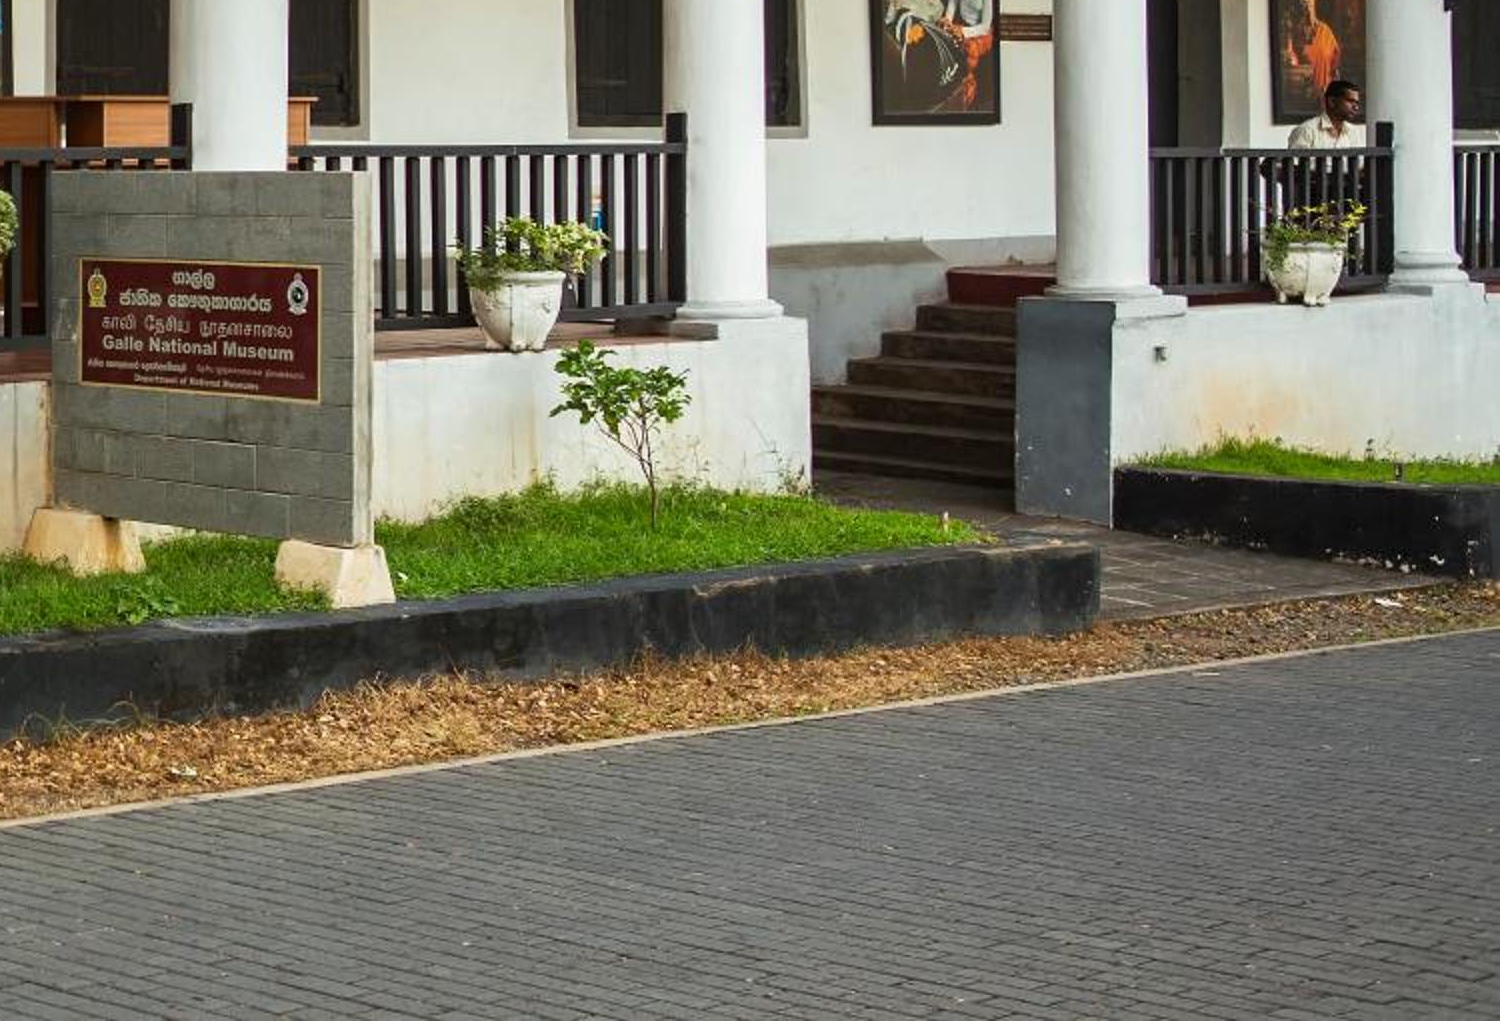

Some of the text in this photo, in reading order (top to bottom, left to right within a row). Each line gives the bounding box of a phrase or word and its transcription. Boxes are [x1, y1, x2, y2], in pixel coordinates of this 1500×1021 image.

[172, 267, 215, 290] ගාල්ල
[119, 288, 162, 307] ජාතික
[101, 313, 137, 330] காலி
[144, 314, 190, 336] தேசிய
[102, 334, 294, 362] Galle National Museum
